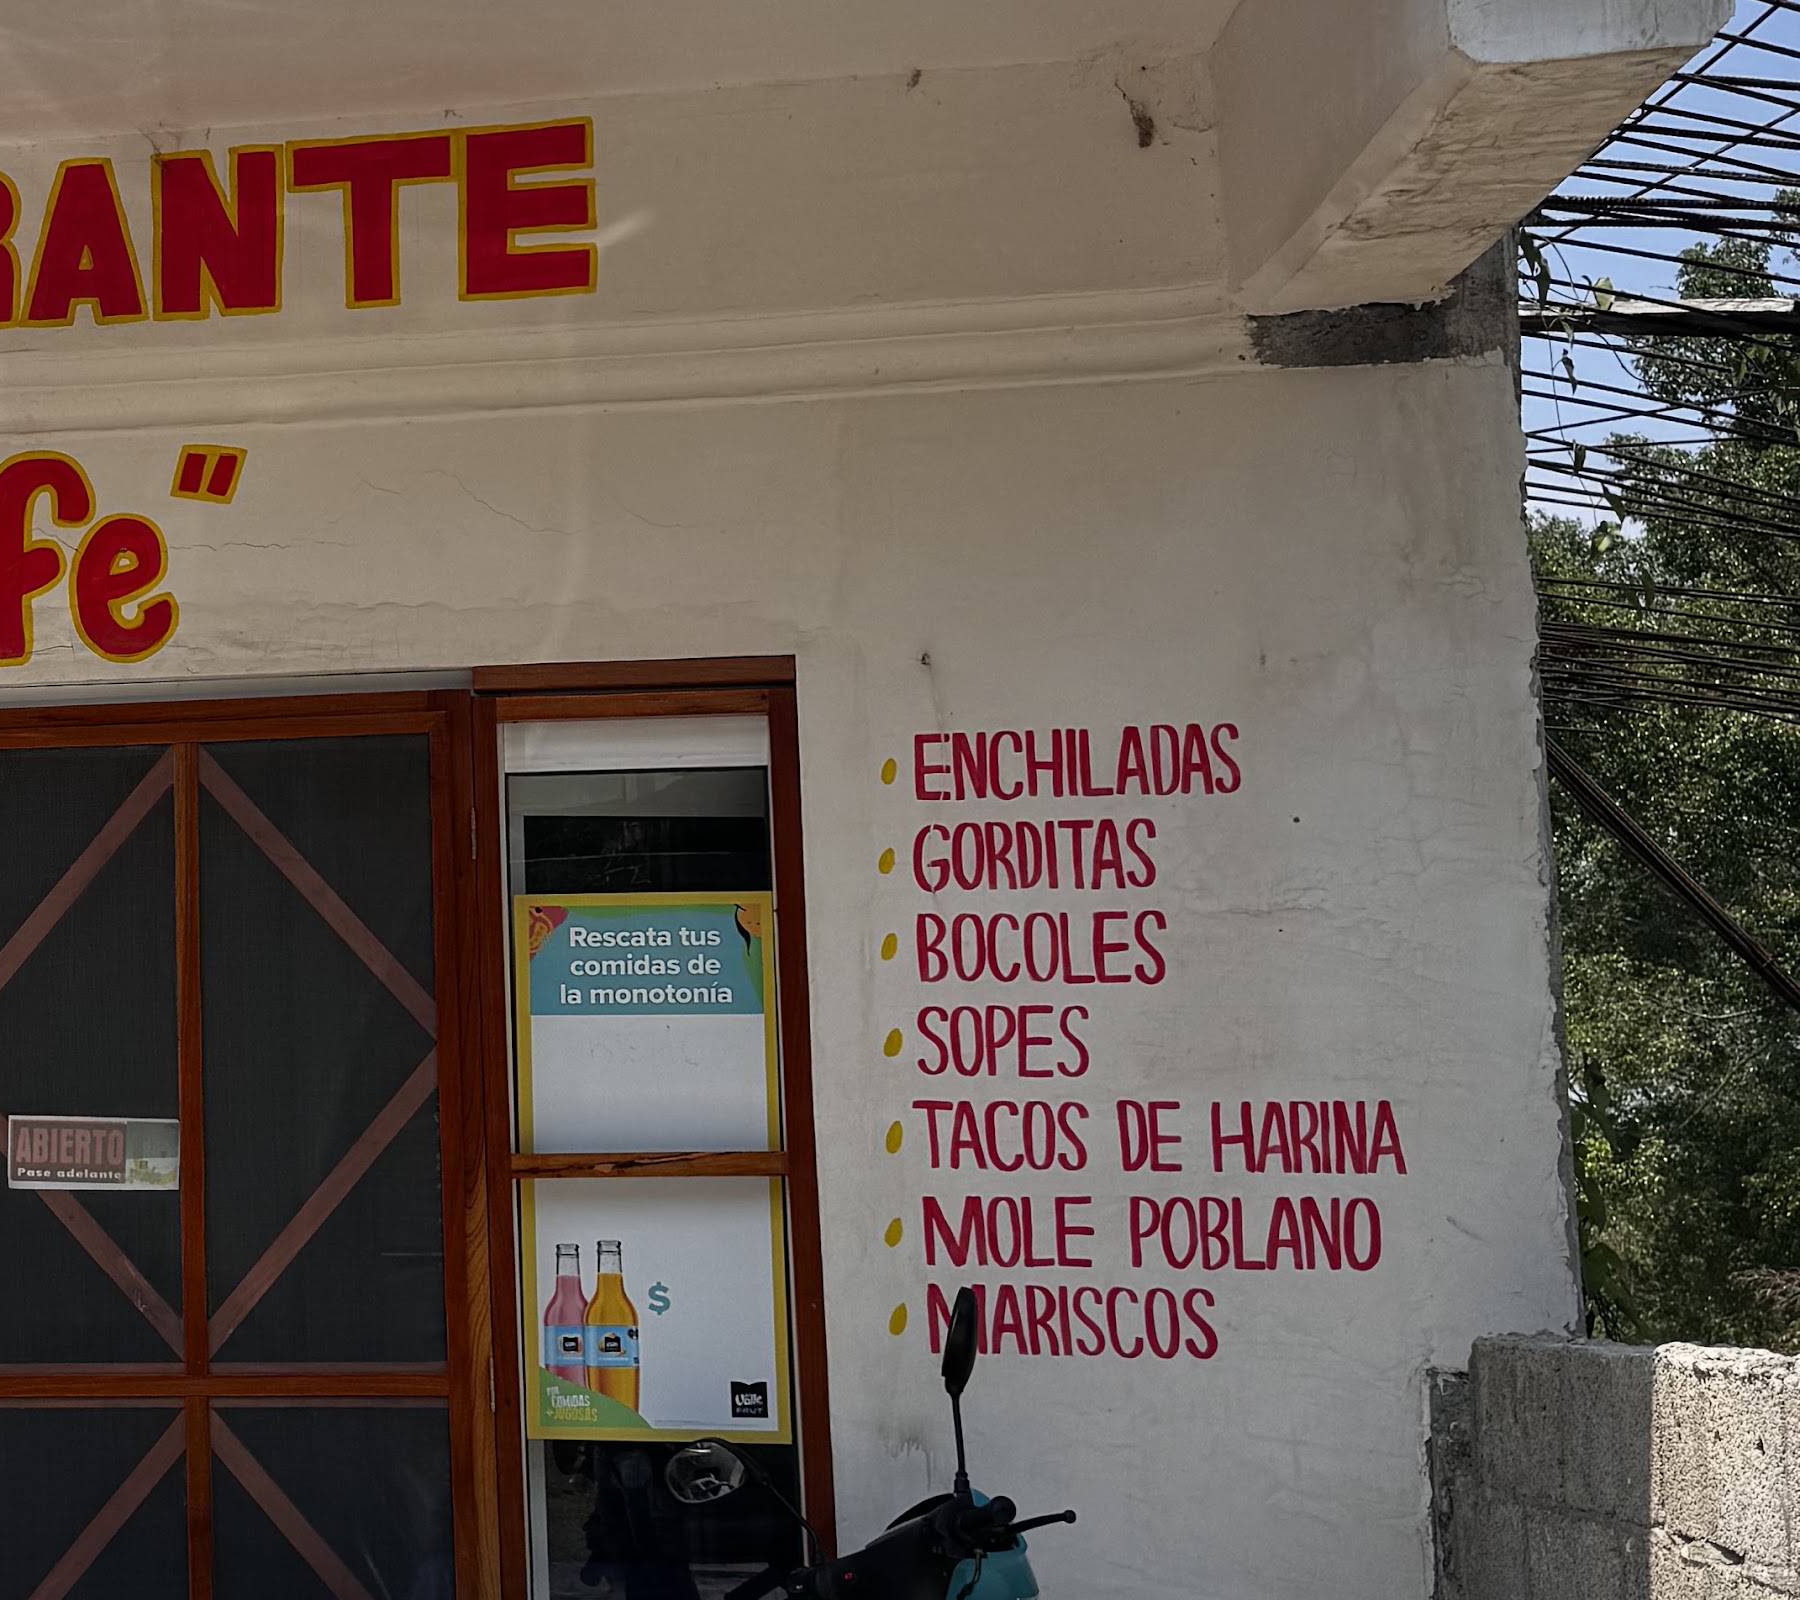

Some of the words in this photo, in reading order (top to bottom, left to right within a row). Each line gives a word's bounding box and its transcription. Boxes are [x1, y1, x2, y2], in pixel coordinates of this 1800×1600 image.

[913, 722, 1241, 801] ENCHILADAS
[912, 818, 1157, 893] GORDITAS
[569, 927, 672, 948] Rescata
[679, 927, 721, 946] tus
[570, 953, 681, 976] comidas
[687, 953, 721, 975] de
[916, 910, 1167, 985] BOCOLES
[560, 984, 582, 1005] la
[590, 981, 733, 1004] monotonía
[916, 1005, 1090, 1078] SOPES
[15, 1127, 125, 1166] ABIERTO
[17, 1167, 51, 1177] Pase
[57, 1168, 122, 1180] adelante
[912, 1100, 1089, 1173] TACOS
[1116, 1100, 1182, 1173] DE
[1210, 1100, 1407, 1175] HARINA
[921, 1196, 1095, 1268] MOLE
[1129, 1196, 1382, 1271] POBLANO
[648, 1281, 671, 1315] $
[926, 1283, 1219, 1359] MARISCOS
